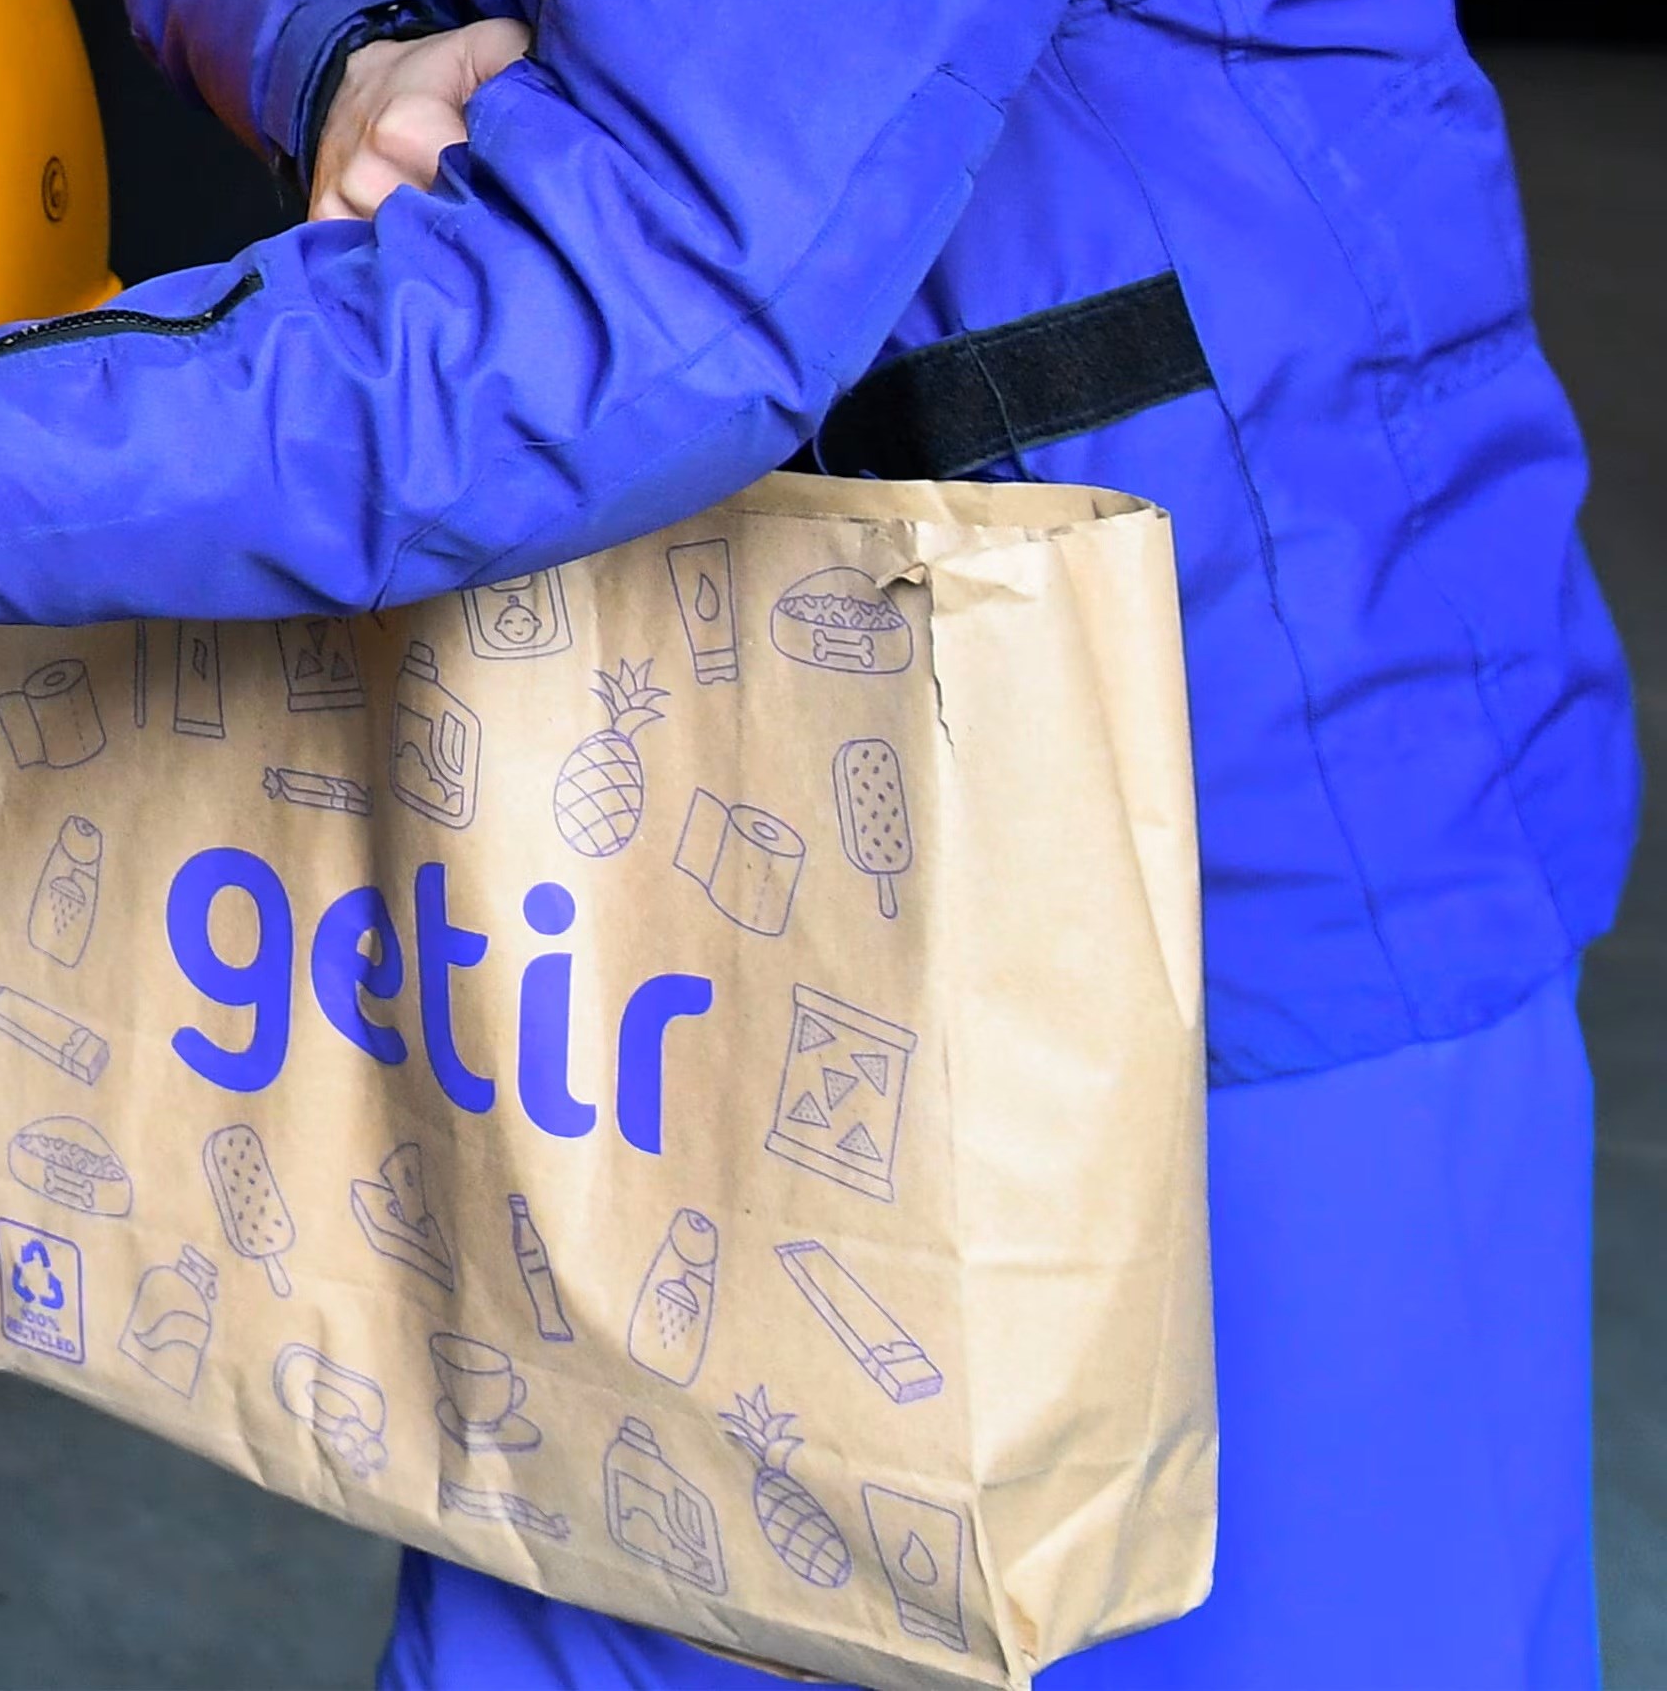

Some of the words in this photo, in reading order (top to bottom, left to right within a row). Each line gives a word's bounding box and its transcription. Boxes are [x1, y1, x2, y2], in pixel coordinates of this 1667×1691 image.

[165, 846, 713, 1156] getir
[5, 1315, 76, 1354] RECYCLED
[20, 1306, 60, 1333] 100%
